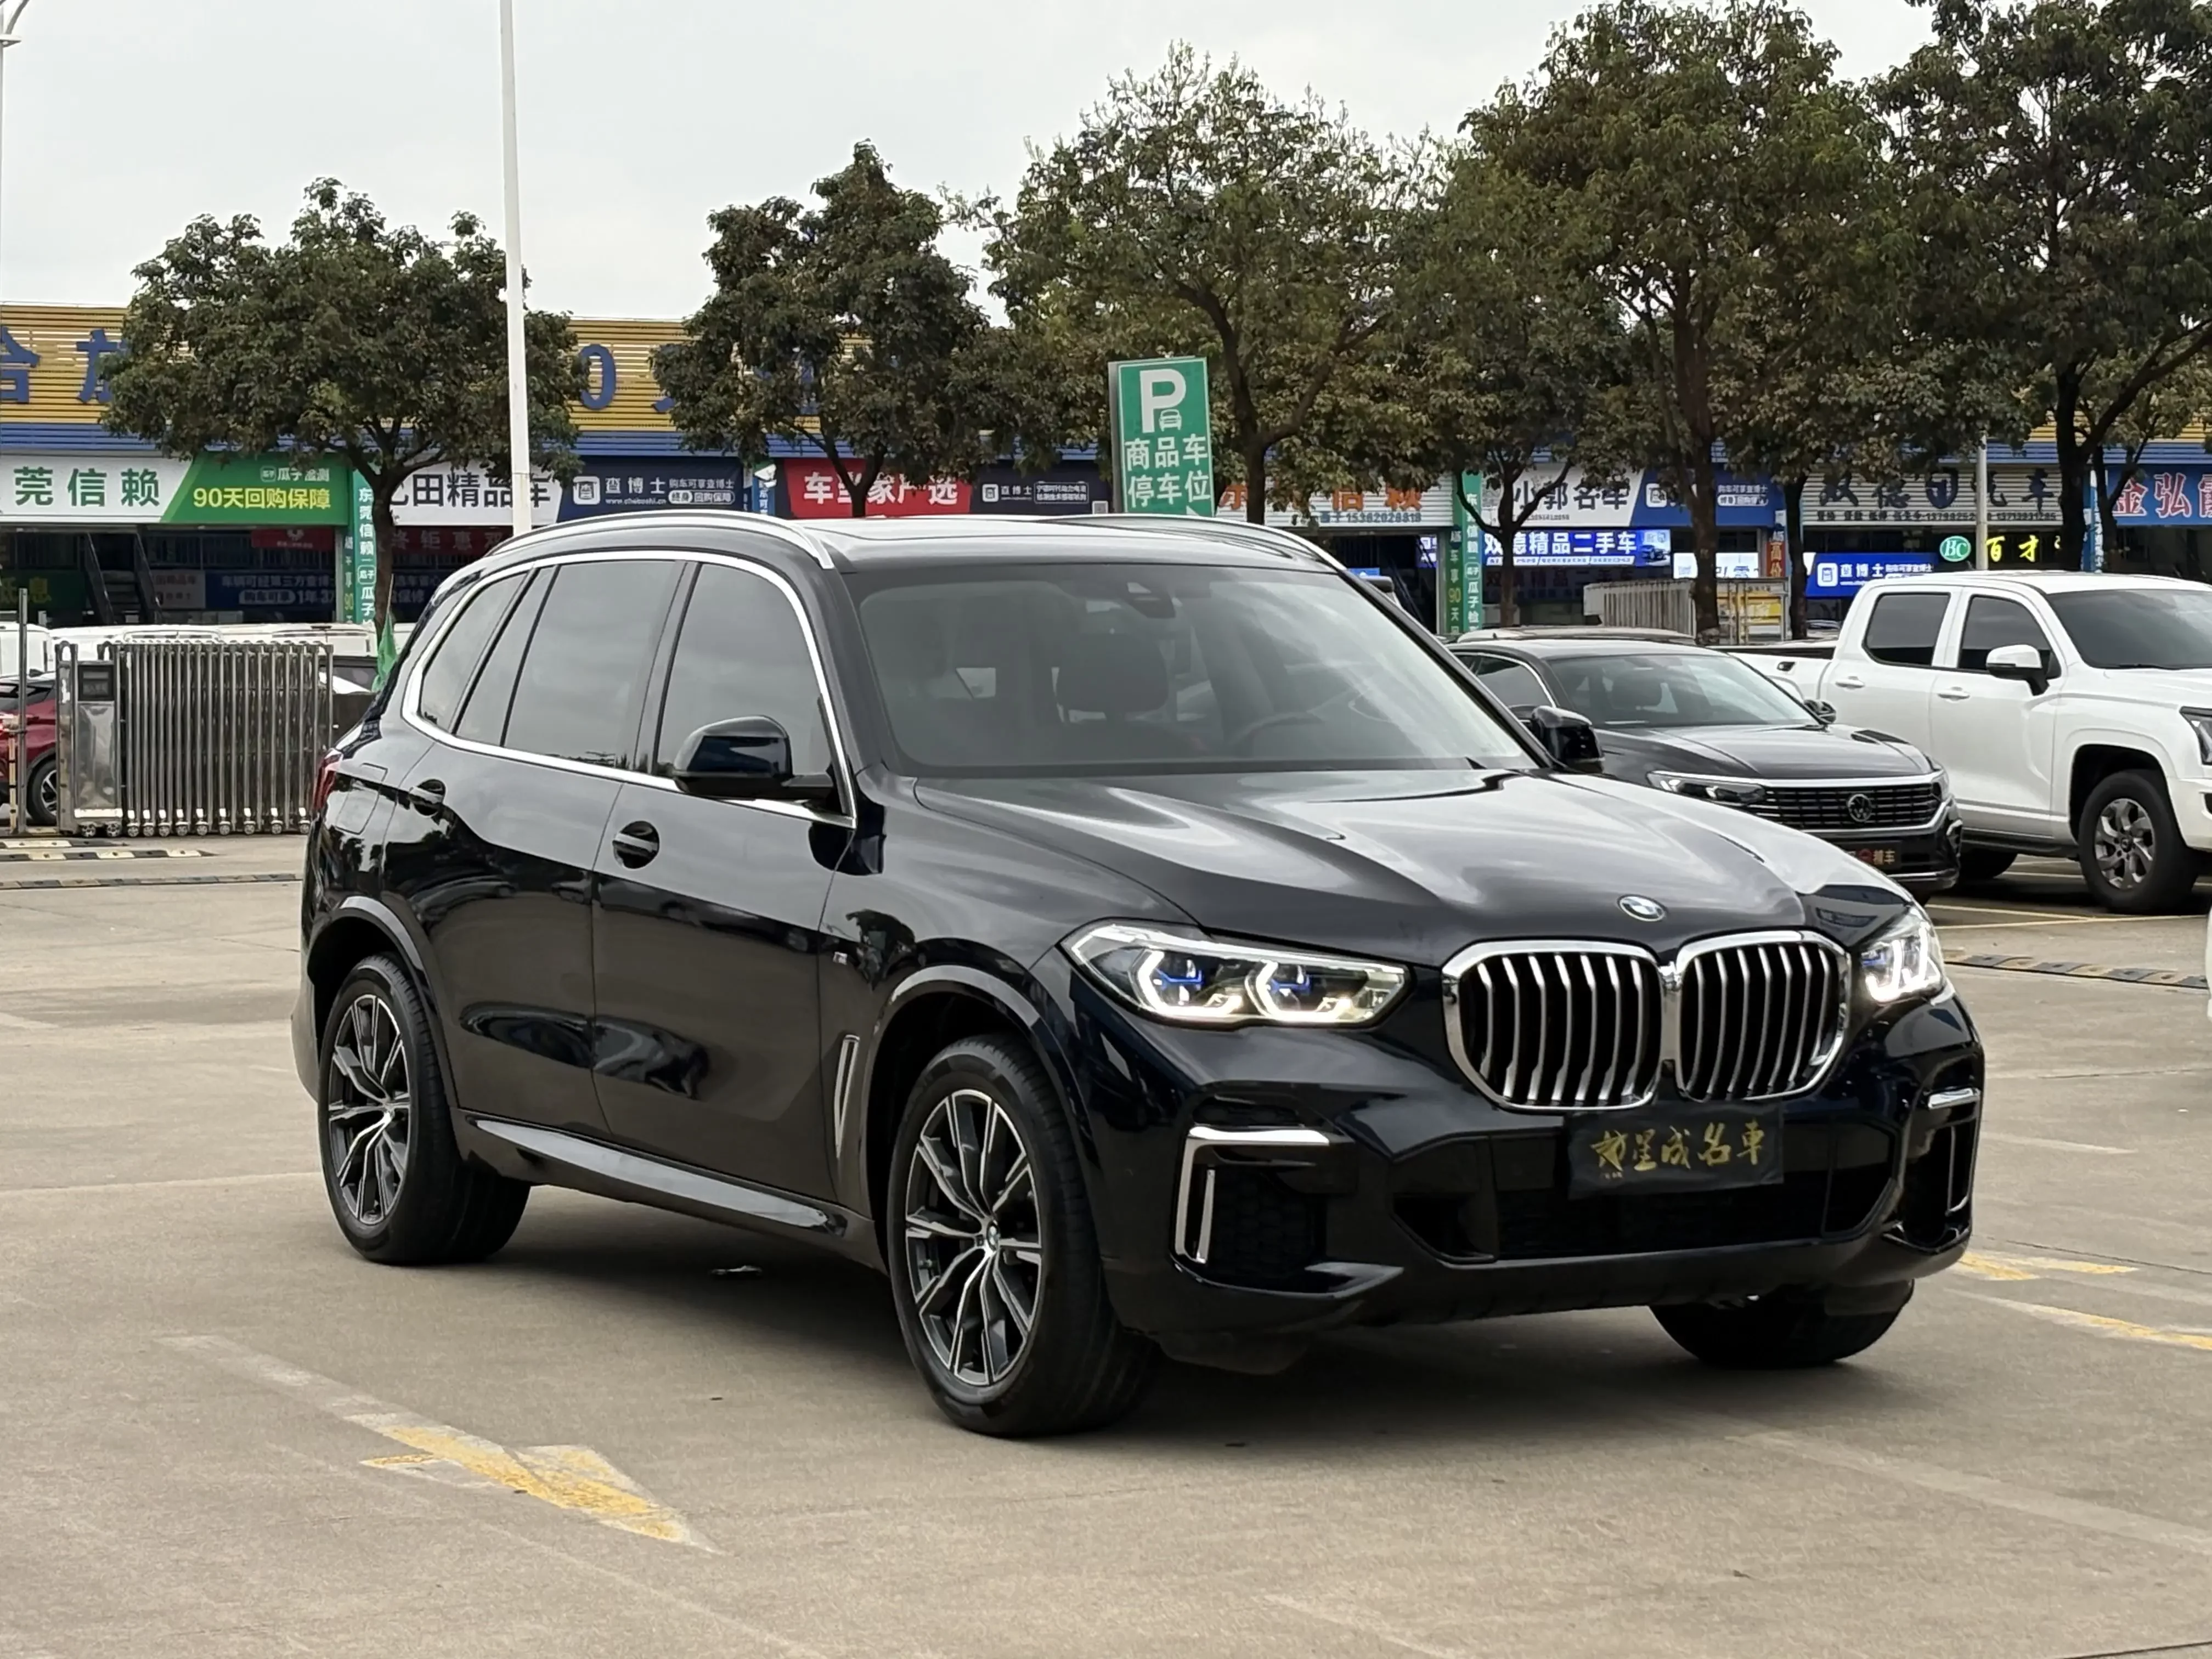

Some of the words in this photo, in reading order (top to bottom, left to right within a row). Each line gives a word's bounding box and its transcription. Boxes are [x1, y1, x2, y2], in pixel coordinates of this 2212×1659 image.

[1139, 368, 1187, 433] P
[1125, 433, 1209, 471] 商品车
[13, 467, 160, 507] 莞信赖
[193, 487, 331, 510] 90天回购保障
[605, 477, 665, 494] 查博士
[1128, 471, 1211, 508] 停车位
